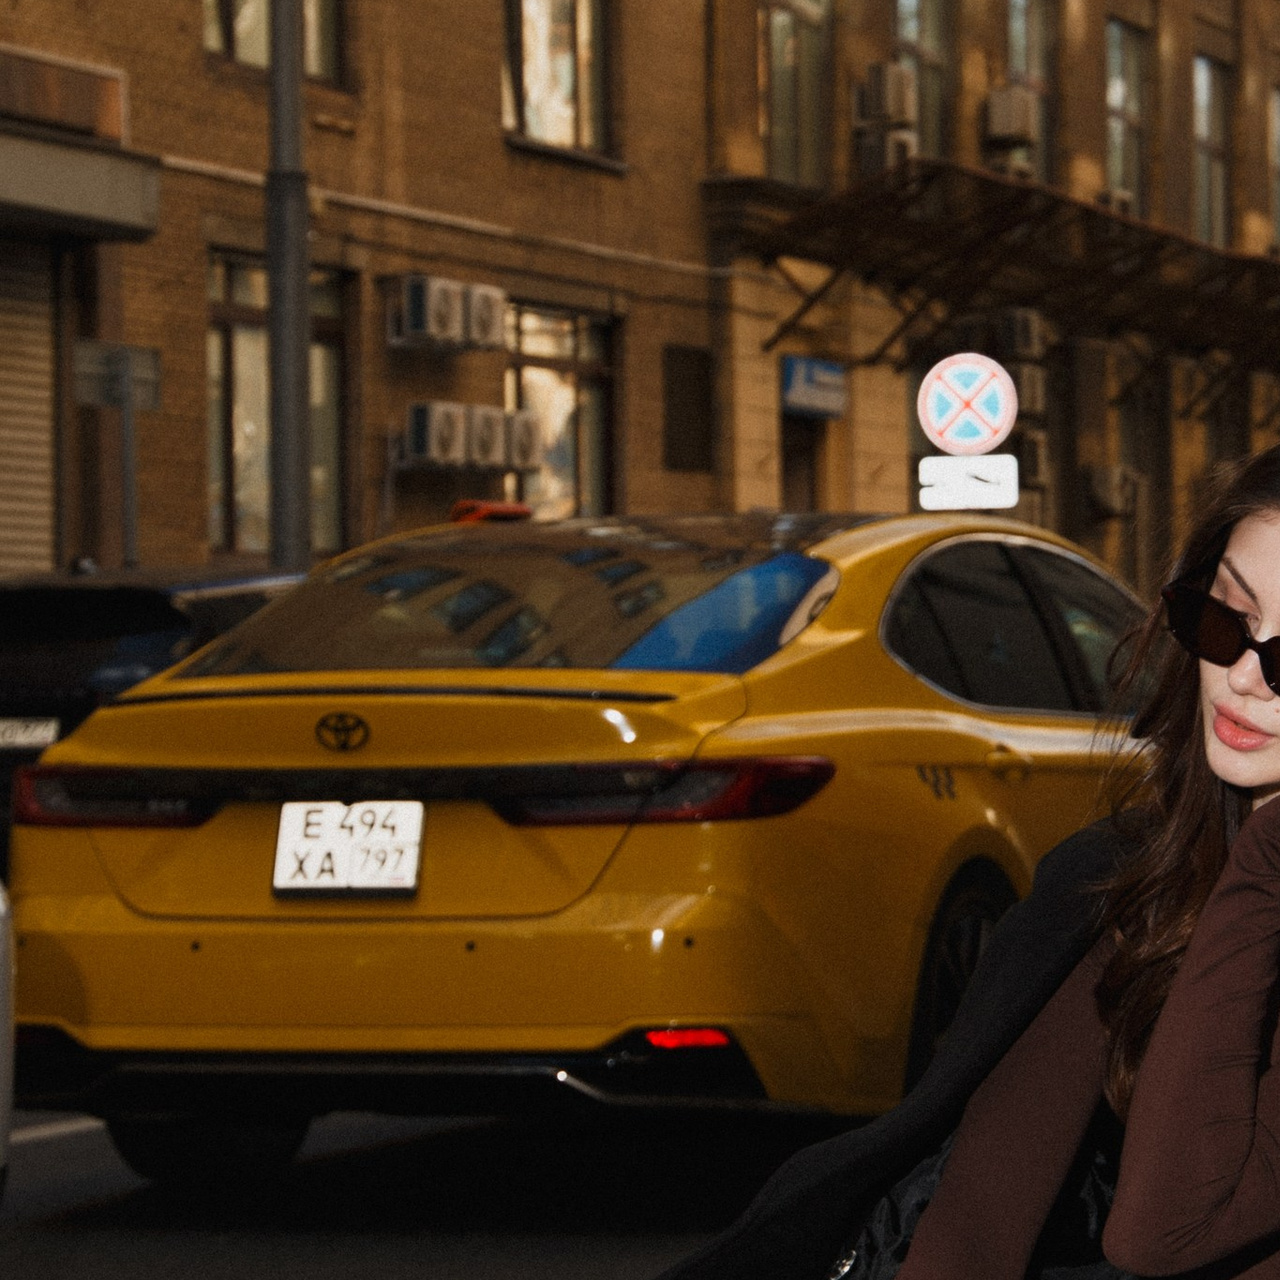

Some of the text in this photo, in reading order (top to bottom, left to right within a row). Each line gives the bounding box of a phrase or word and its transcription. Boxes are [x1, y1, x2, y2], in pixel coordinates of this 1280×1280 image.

[303, 807, 397, 839] Е 494
[359, 847, 405, 872] 797
